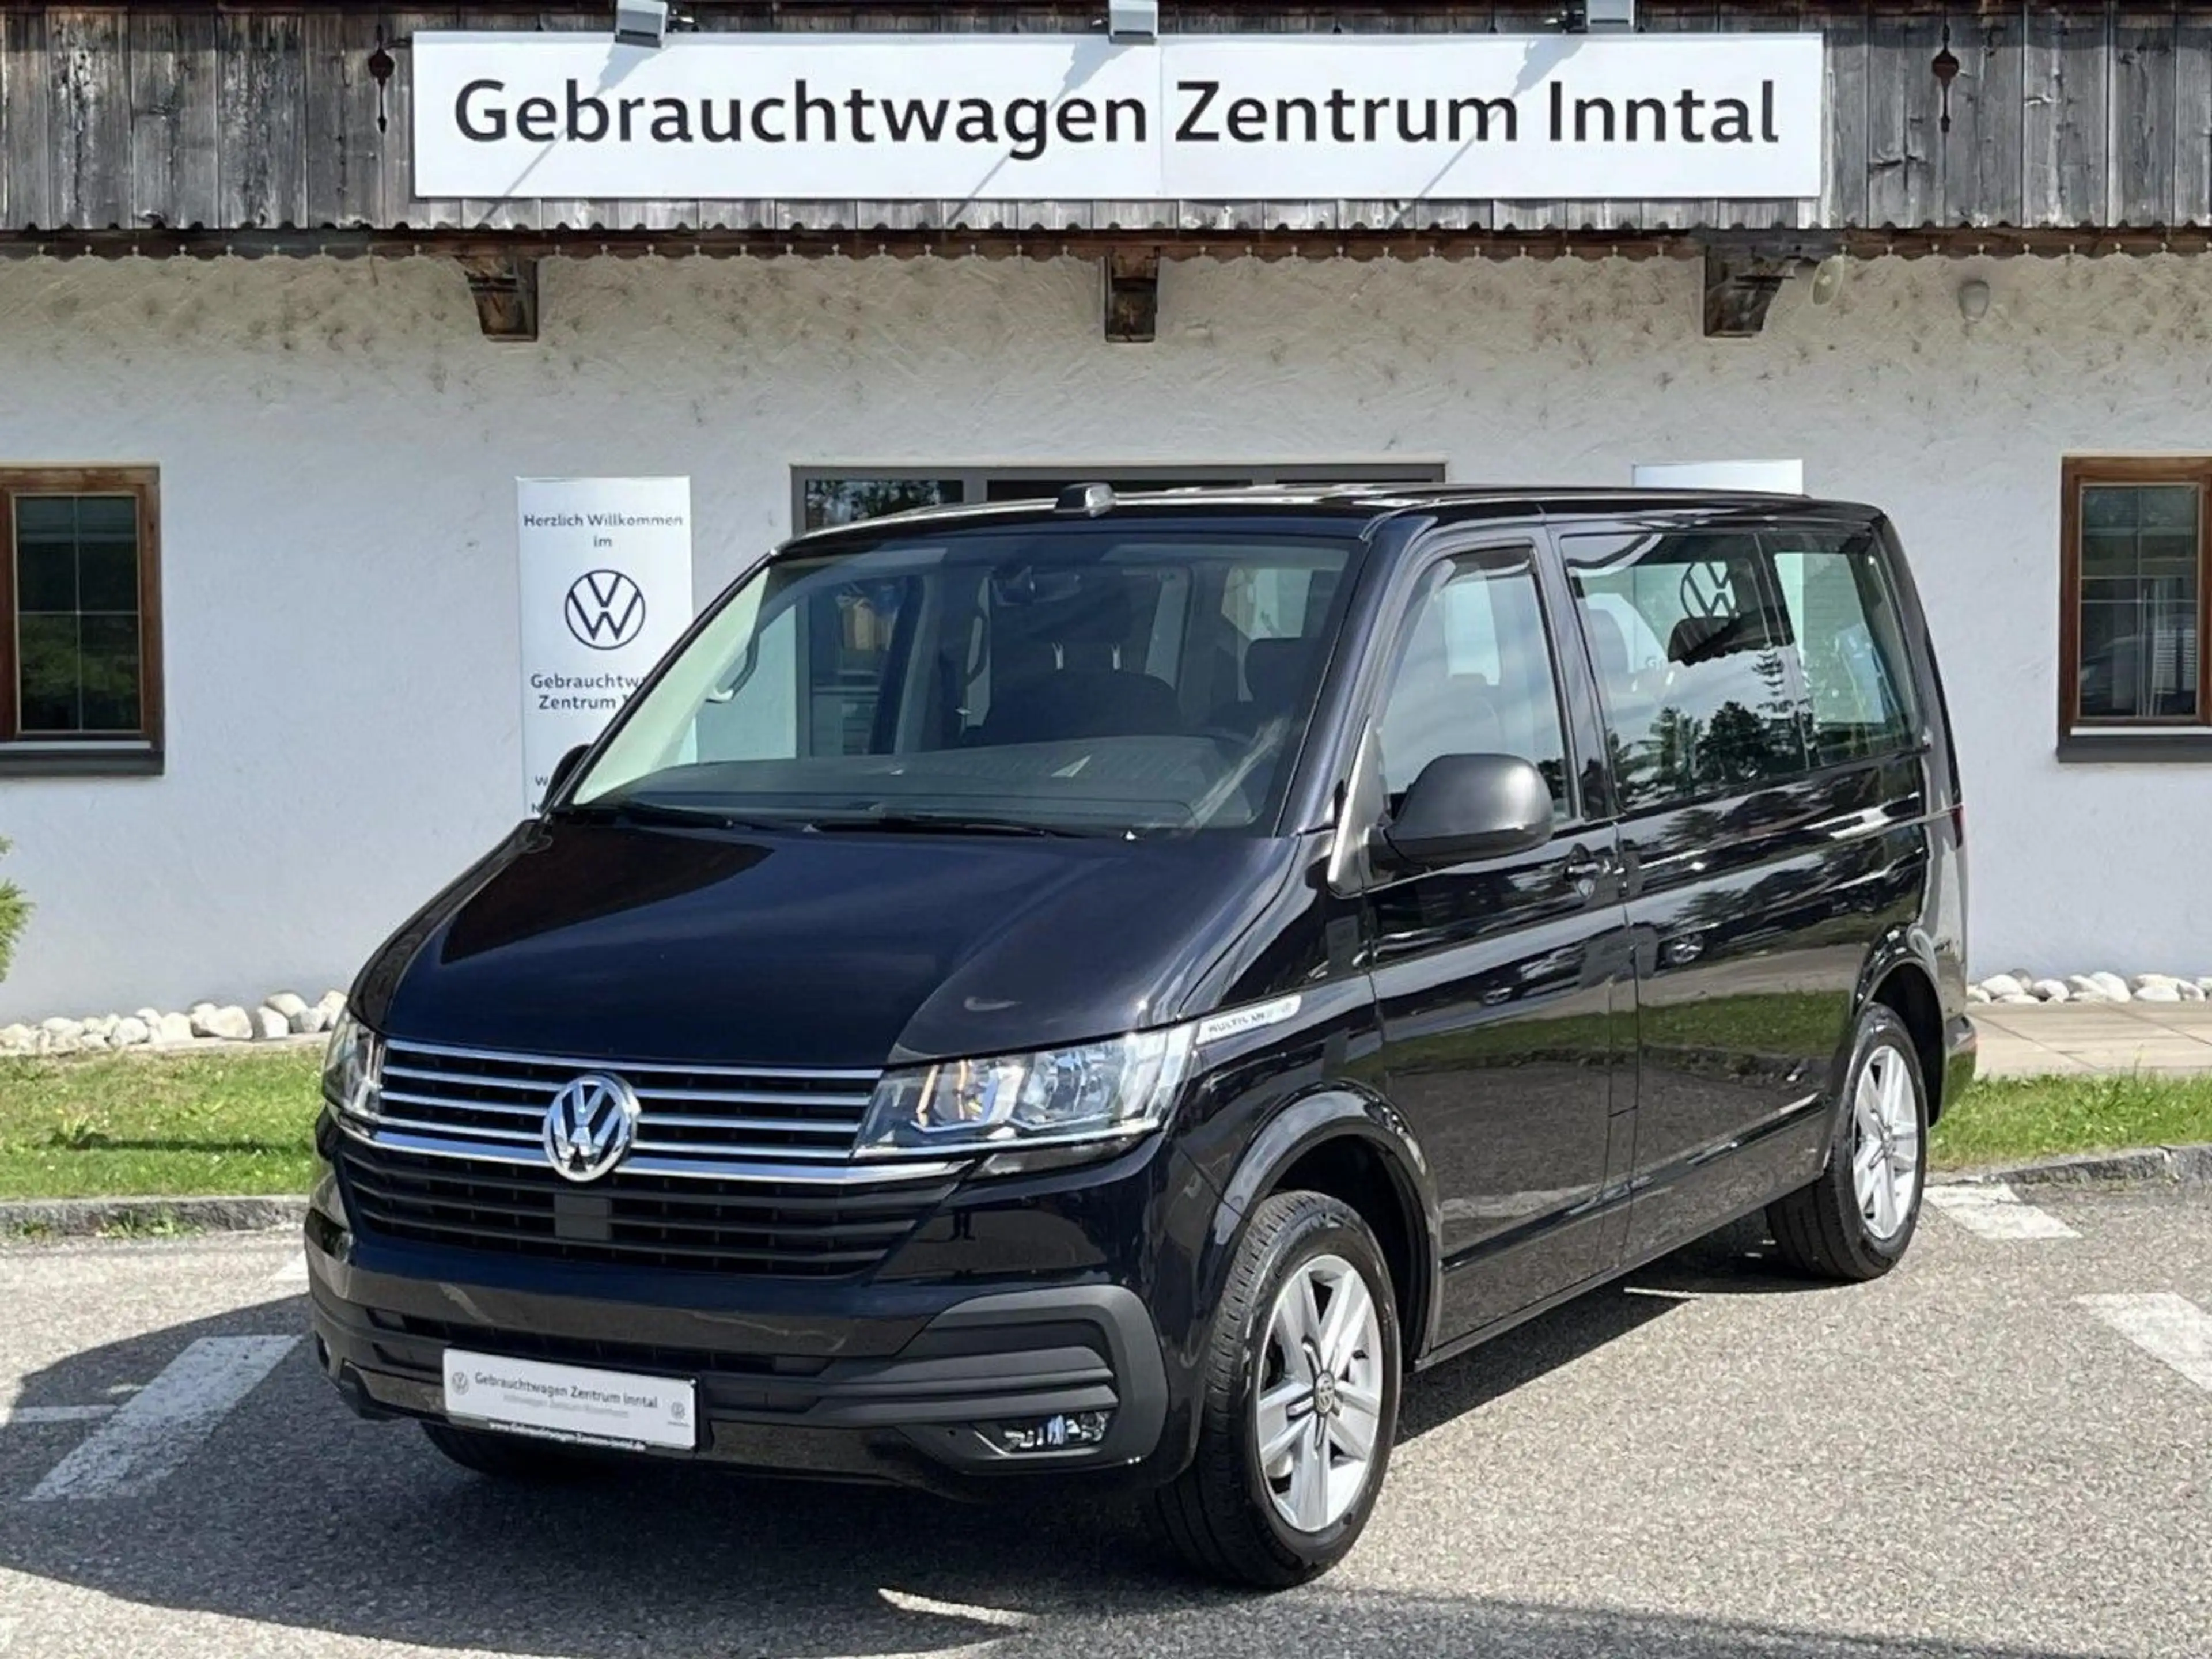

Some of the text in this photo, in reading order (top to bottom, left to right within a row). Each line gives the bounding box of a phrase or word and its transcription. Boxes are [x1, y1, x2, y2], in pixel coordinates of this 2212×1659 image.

[455, 78, 1779, 161] Gebrauchtwagen Zentrum Inntal
[524, 513, 683, 527] Herzlich Willkommen
[593, 536, 612, 548] im
[565, 569, 646, 650] VW
[530, 672, 646, 690] Gebrauchtw
[538, 694, 616, 710] Zentrum
[542, 1074, 641, 1181] VW
[570, 1385, 621, 1404] Zentrum
